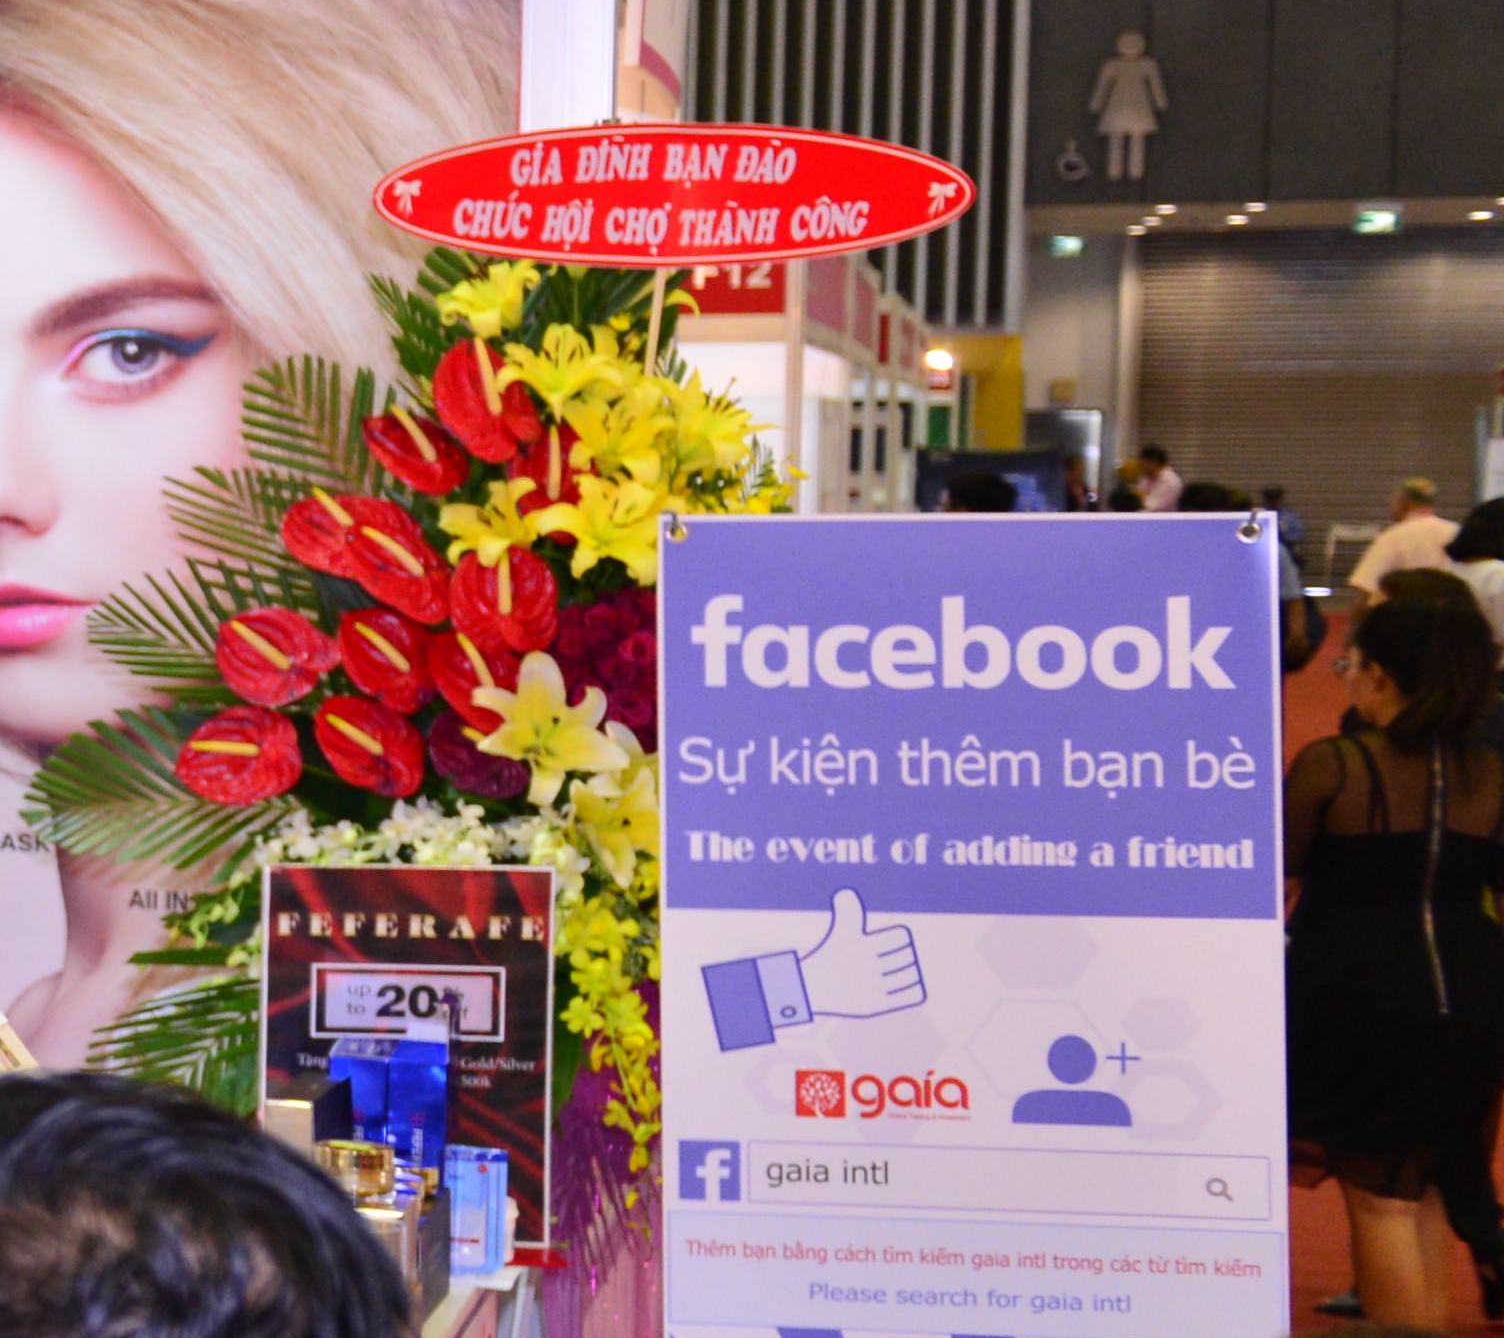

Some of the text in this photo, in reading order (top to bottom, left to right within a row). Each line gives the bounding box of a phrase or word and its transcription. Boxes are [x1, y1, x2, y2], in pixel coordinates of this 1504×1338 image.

[663, 143, 724, 188] BẠN
[734, 138, 798, 185] ĐÀO
[452, 190, 534, 239] CHÚC
[679, 201, 781, 247] THÀNH
[791, 195, 871, 242] CÔNG
[691, 593, 1236, 691] facebook
[679, 733, 1257, 799] Sự kiện thêm bạn bè
[686, 830, 1255, 870] The event of adding a friend
[129, 889, 160, 911] All
[276, 911, 546, 943] FEFERAFE
[346, 1000, 367, 1016] to
[347, 982, 372, 999] up
[376, 984, 440, 1020] 20
[459, 1056, 536, 1073] Gold/Silver
[765, 1158, 830, 1188] gaia
[841, 1159, 889, 1186] intl
[686, 1239, 737, 1259] Thêm
[742, 1241, 776, 1262] bạn
[834, 1244, 876, 1263] cách
[882, 1245, 913, 1263] tìm
[971, 1252, 1011, 1272] gaia
[1017, 1252, 1046, 1269] intl
[1052, 1254, 1105, 1275] trong
[1110, 1254, 1142, 1274] các
[1174, 1256, 1207, 1275] tìm
[809, 1281, 1132, 1314] Please search for gaia intl
